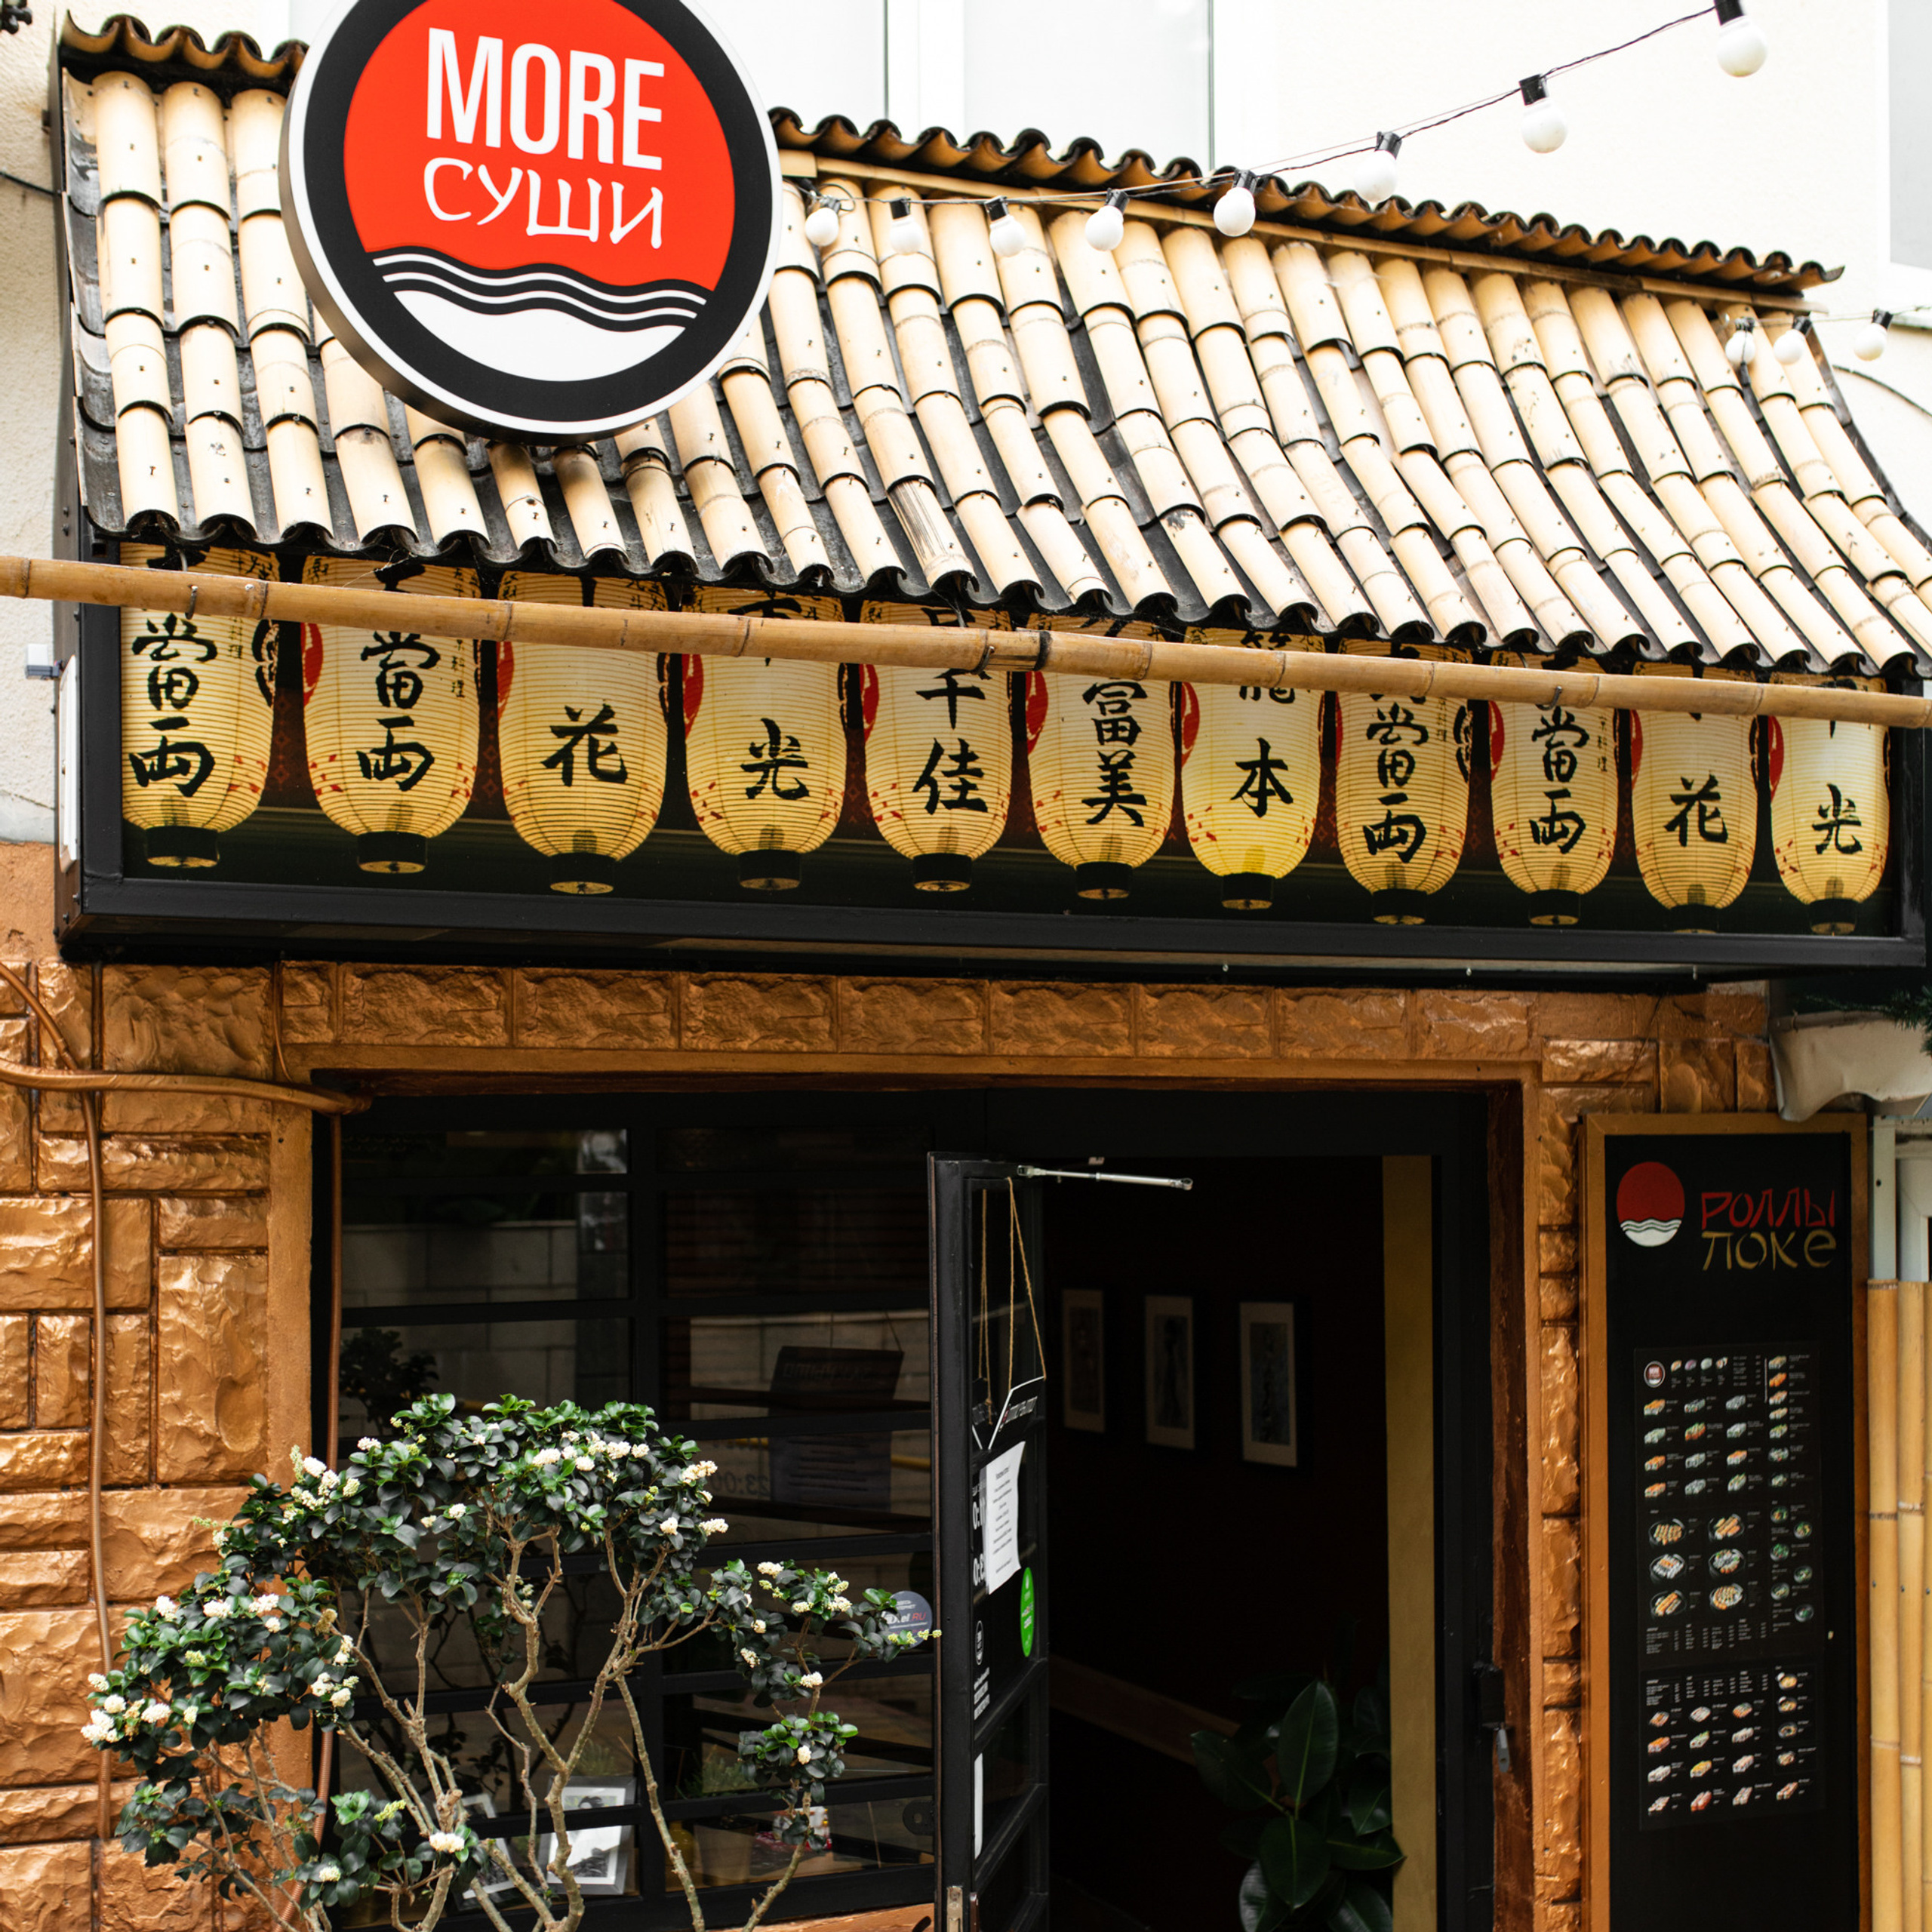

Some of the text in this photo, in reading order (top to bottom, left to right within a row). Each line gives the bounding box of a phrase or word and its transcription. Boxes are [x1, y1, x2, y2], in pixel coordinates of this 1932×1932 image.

[427, 28, 665, 171] MORE
[424, 157, 663, 250] СУШИ
[1080, 617, 1148, 828] 富美
[1701, 1188, 1835, 1229] РОЛЛЫ
